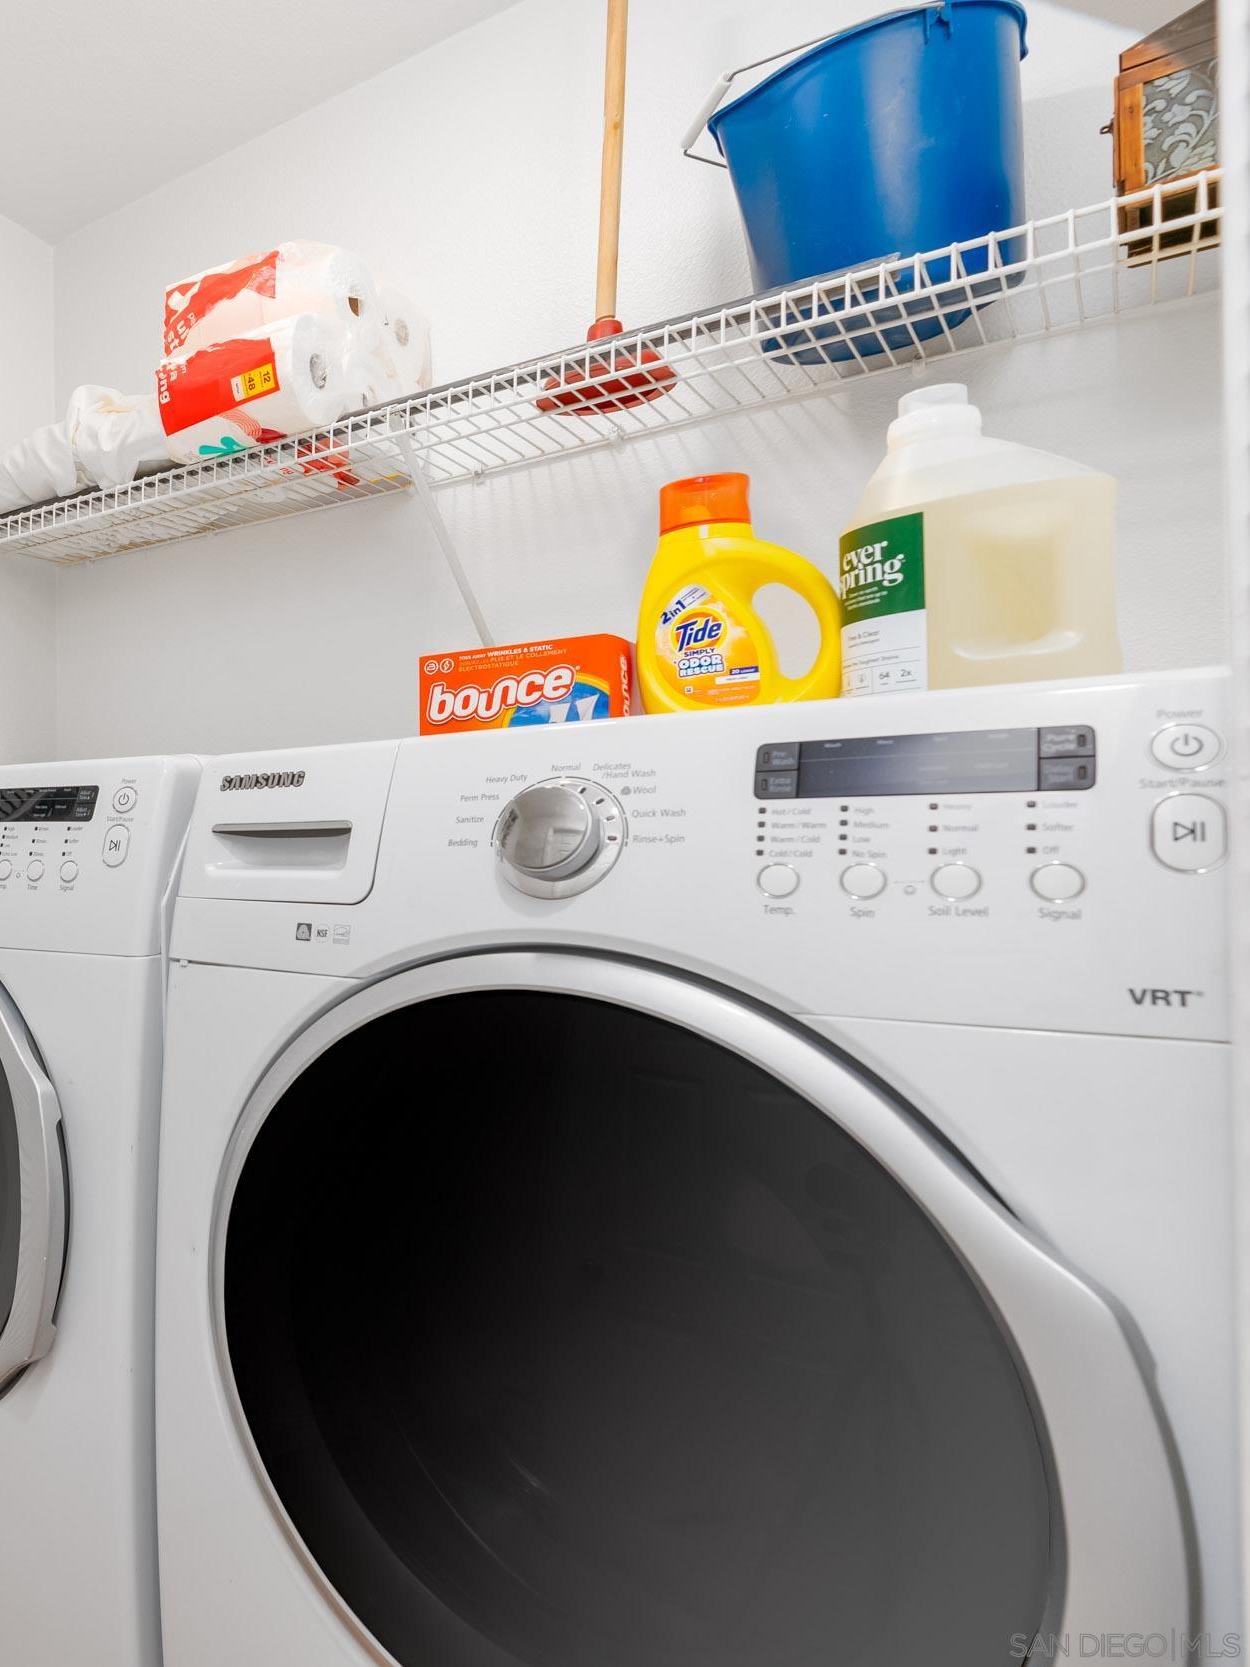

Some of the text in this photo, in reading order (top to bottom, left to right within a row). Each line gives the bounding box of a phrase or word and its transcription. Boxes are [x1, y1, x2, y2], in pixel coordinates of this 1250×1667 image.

[247, 376, 256, 391] 48
[843, 540, 889, 571] ever
[839, 553, 905, 601] pring
[675, 618, 723, 652] Tide
[487, 647, 522, 657] WRINKLES
[529, 644, 554, 653] STATIC
[684, 647, 716, 657] SIMPLY
[678, 653, 723, 670] ODOR
[679, 664, 725, 677] RESCUE
[620, 656, 630, 717] ounce
[427, 664, 576, 724] bounce
[1156, 709, 1203, 719] Power
[551, 763, 581, 772] Normal
[592, 762, 631, 771] Delicates
[631, 769, 656, 777] Wash
[220, 770, 306, 791] SAMSUNG
[485, 773, 528, 785] Heavy Duty
[633, 785, 657, 794] Wool
[480, 792, 500, 801] Press
[631, 808, 686, 819] Quick Wash
[455, 815, 484, 824] Sanitize
[853, 820, 889, 829] Medium
[943, 824, 979, 832] Normal
[447, 838, 478, 848] Bedding
[852, 835, 871, 843] Low
[942, 847, 967, 857] Light
[763, 904, 795, 917] Temp.
[850, 906, 876, 919] Spin
[928, 905, 989, 917] Soil Level
[1038, 907, 1082, 921] Signal
[316, 929, 328, 938] NSF
